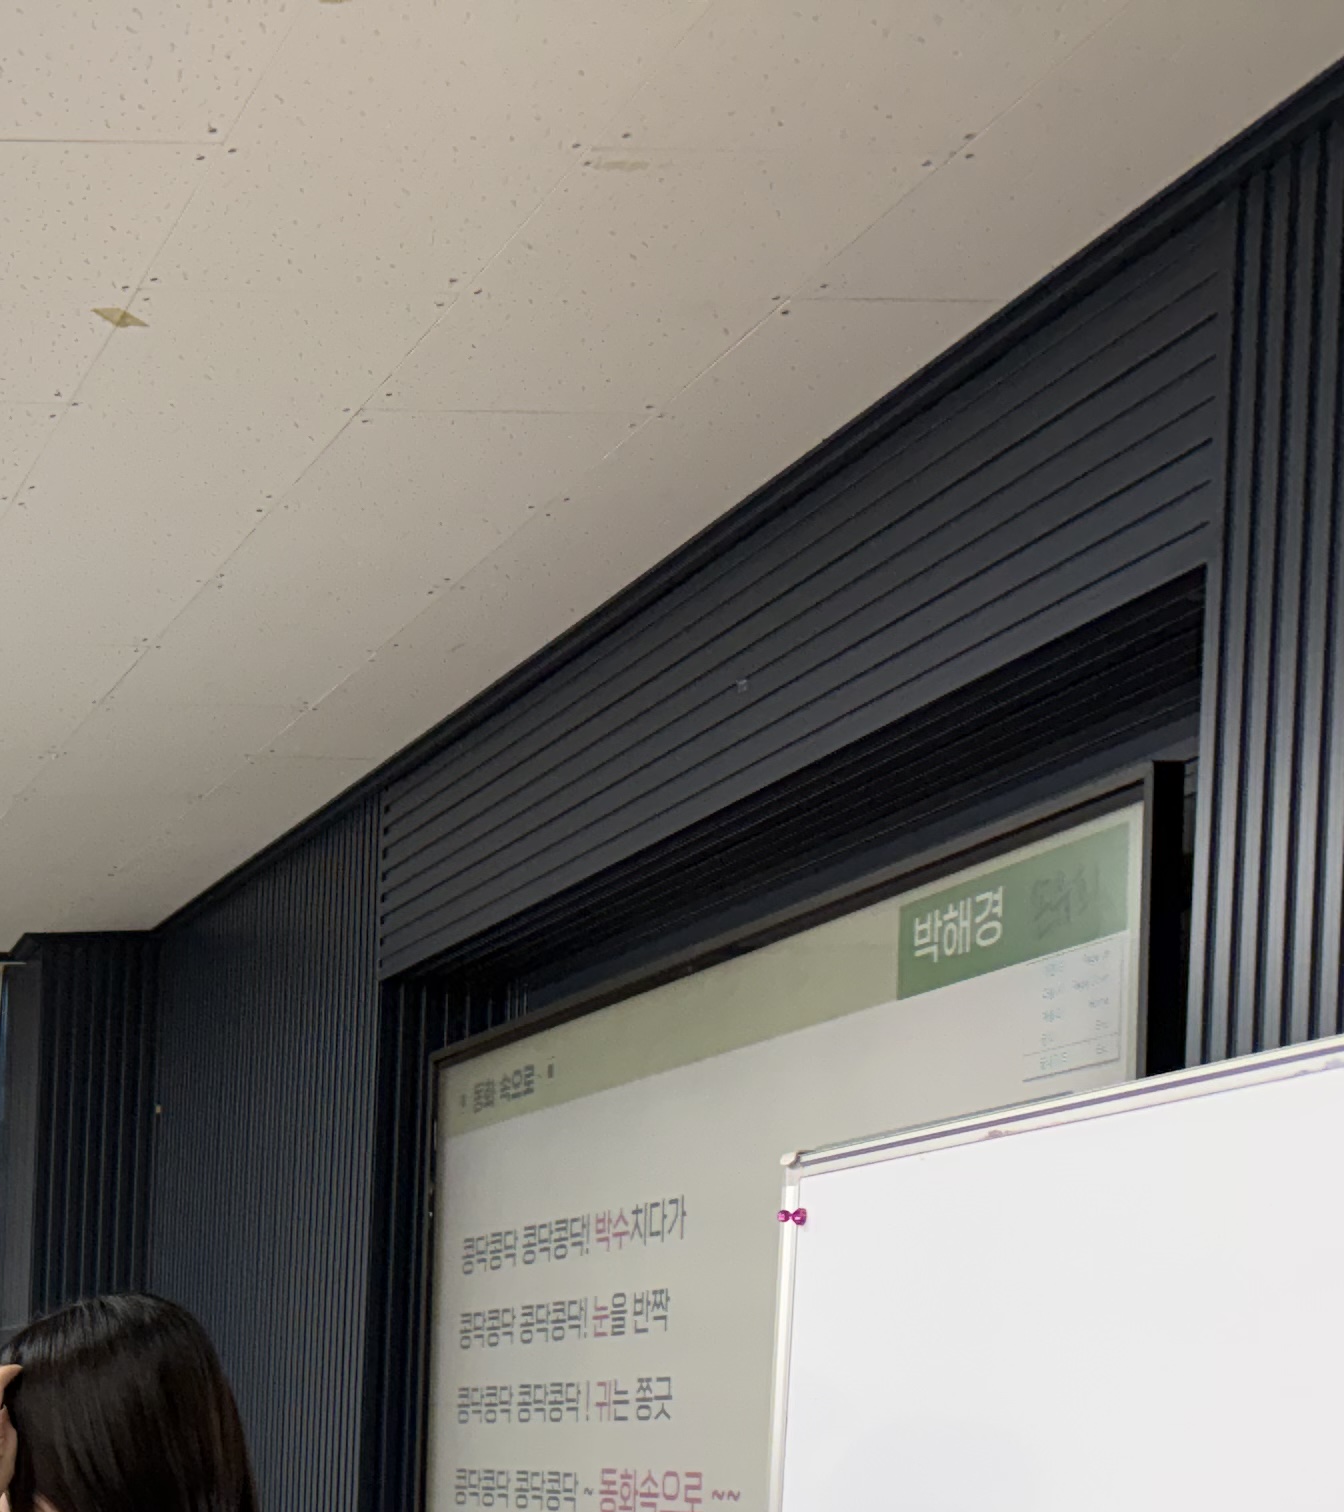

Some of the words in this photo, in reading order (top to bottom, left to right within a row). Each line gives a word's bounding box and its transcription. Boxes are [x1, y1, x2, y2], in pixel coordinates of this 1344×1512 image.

[914, 886, 1003, 962] 박해경
[462, 1229, 519, 1275] 콩닥콩닥
[522, 1213, 590, 1265] 콩닥콩닥!
[595, 1194, 687, 1252] 박수치다가
[459, 1307, 516, 1350] 콩닥콩닥
[520, 1297, 589, 1345] 콩닥콩닥!
[592, 1292, 628, 1337] 눈을
[633, 1288, 671, 1334] 반짝
[458, 1385, 514, 1424] 콩닥콩닥
[595, 1379, 630, 1422] 귀는
[635, 1376, 673, 1421] 쫑긋
[455, 1467, 511, 1509] 콩닥콩닥
